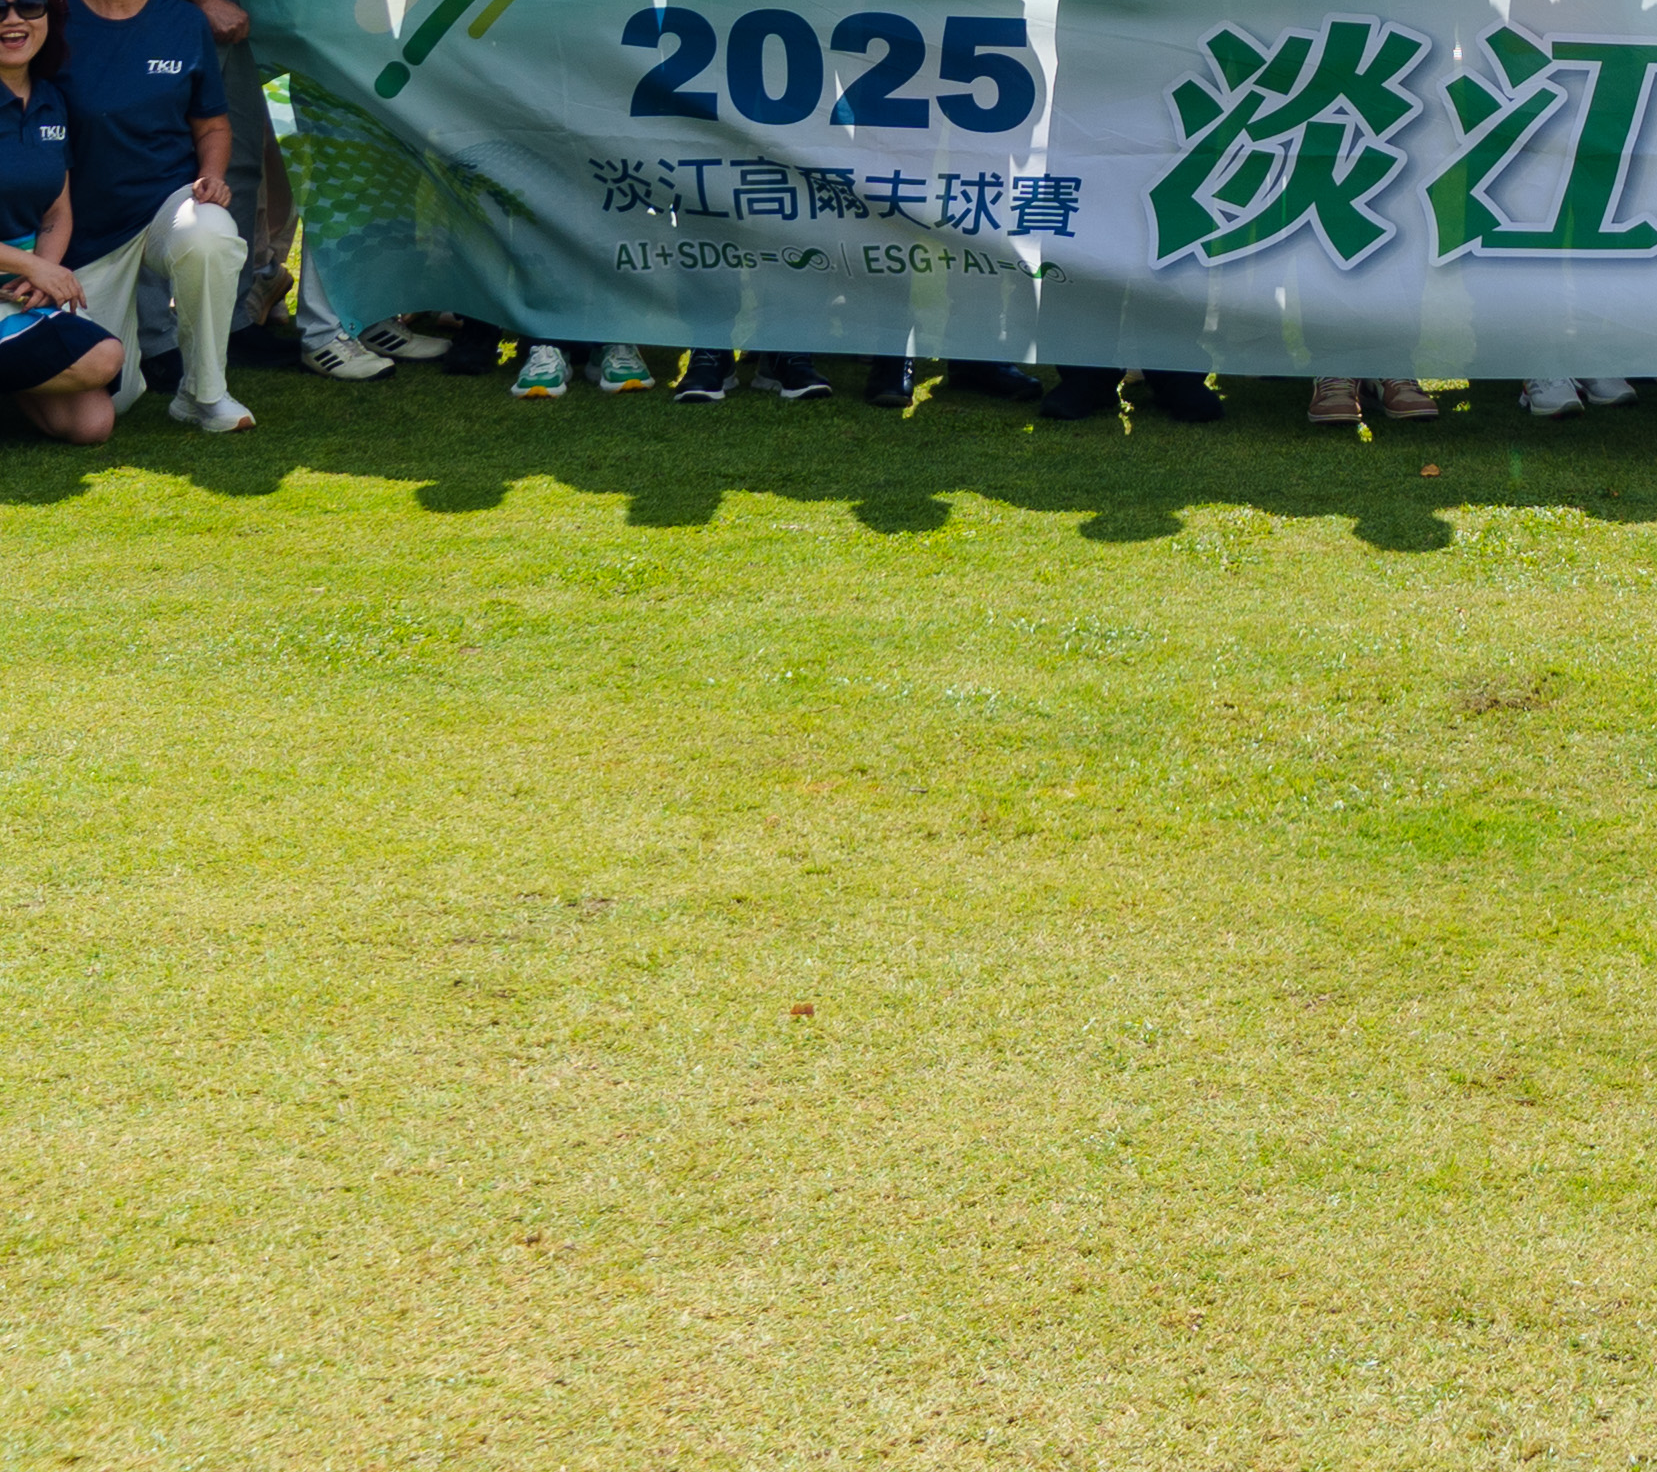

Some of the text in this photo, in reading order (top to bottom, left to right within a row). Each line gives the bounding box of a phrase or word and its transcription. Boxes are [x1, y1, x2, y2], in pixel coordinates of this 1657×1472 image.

[147, 59, 182, 74] TKU
[619, 6, 1037, 134] 2025
[40, 126, 66, 140] TKU
[588, 155, 1082, 238] 淡江高爾夫球賽
